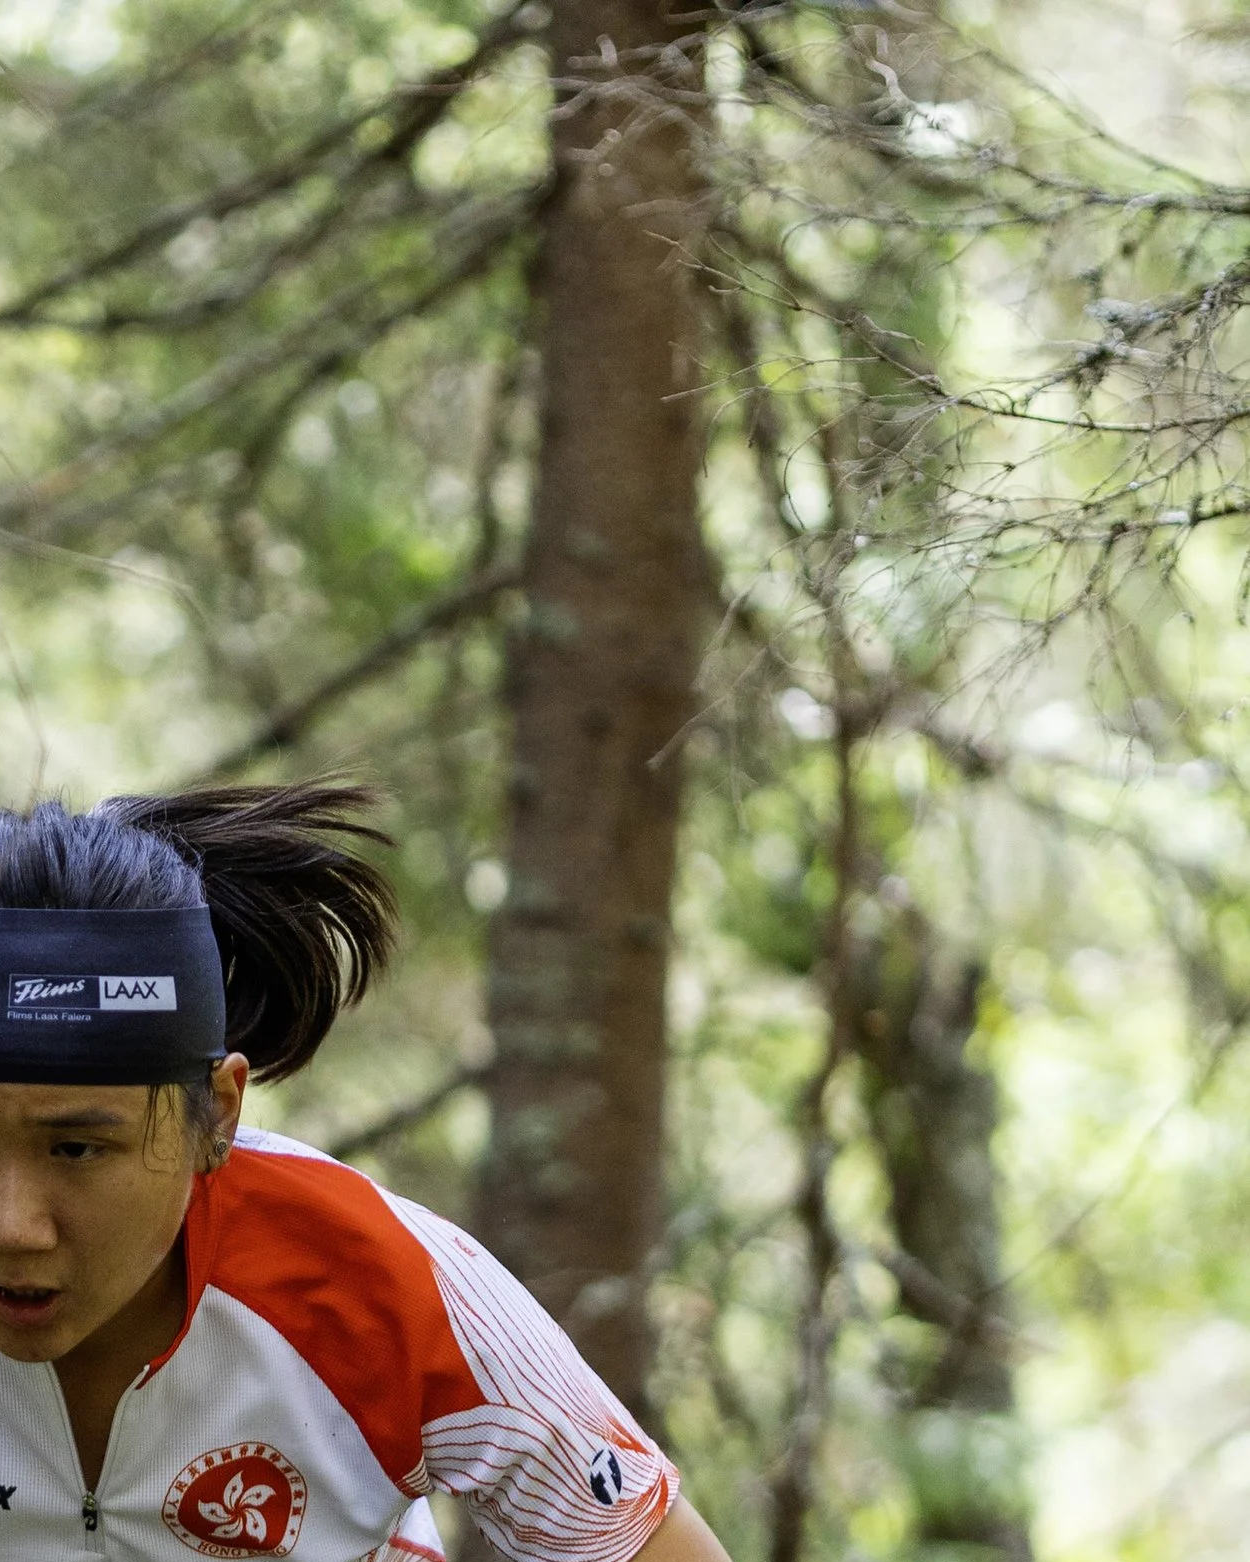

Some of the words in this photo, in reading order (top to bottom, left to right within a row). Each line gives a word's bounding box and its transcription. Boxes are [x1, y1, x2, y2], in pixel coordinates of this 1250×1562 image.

[14, 978, 85, 1003] Flims
[104, 980, 159, 999] LAAX
[7, 1011, 33, 1019] Flims
[35, 1012, 58, 1020] Laax
[61, 1012, 91, 1021] Falera
[197, 1541, 241, 1556] HONG
